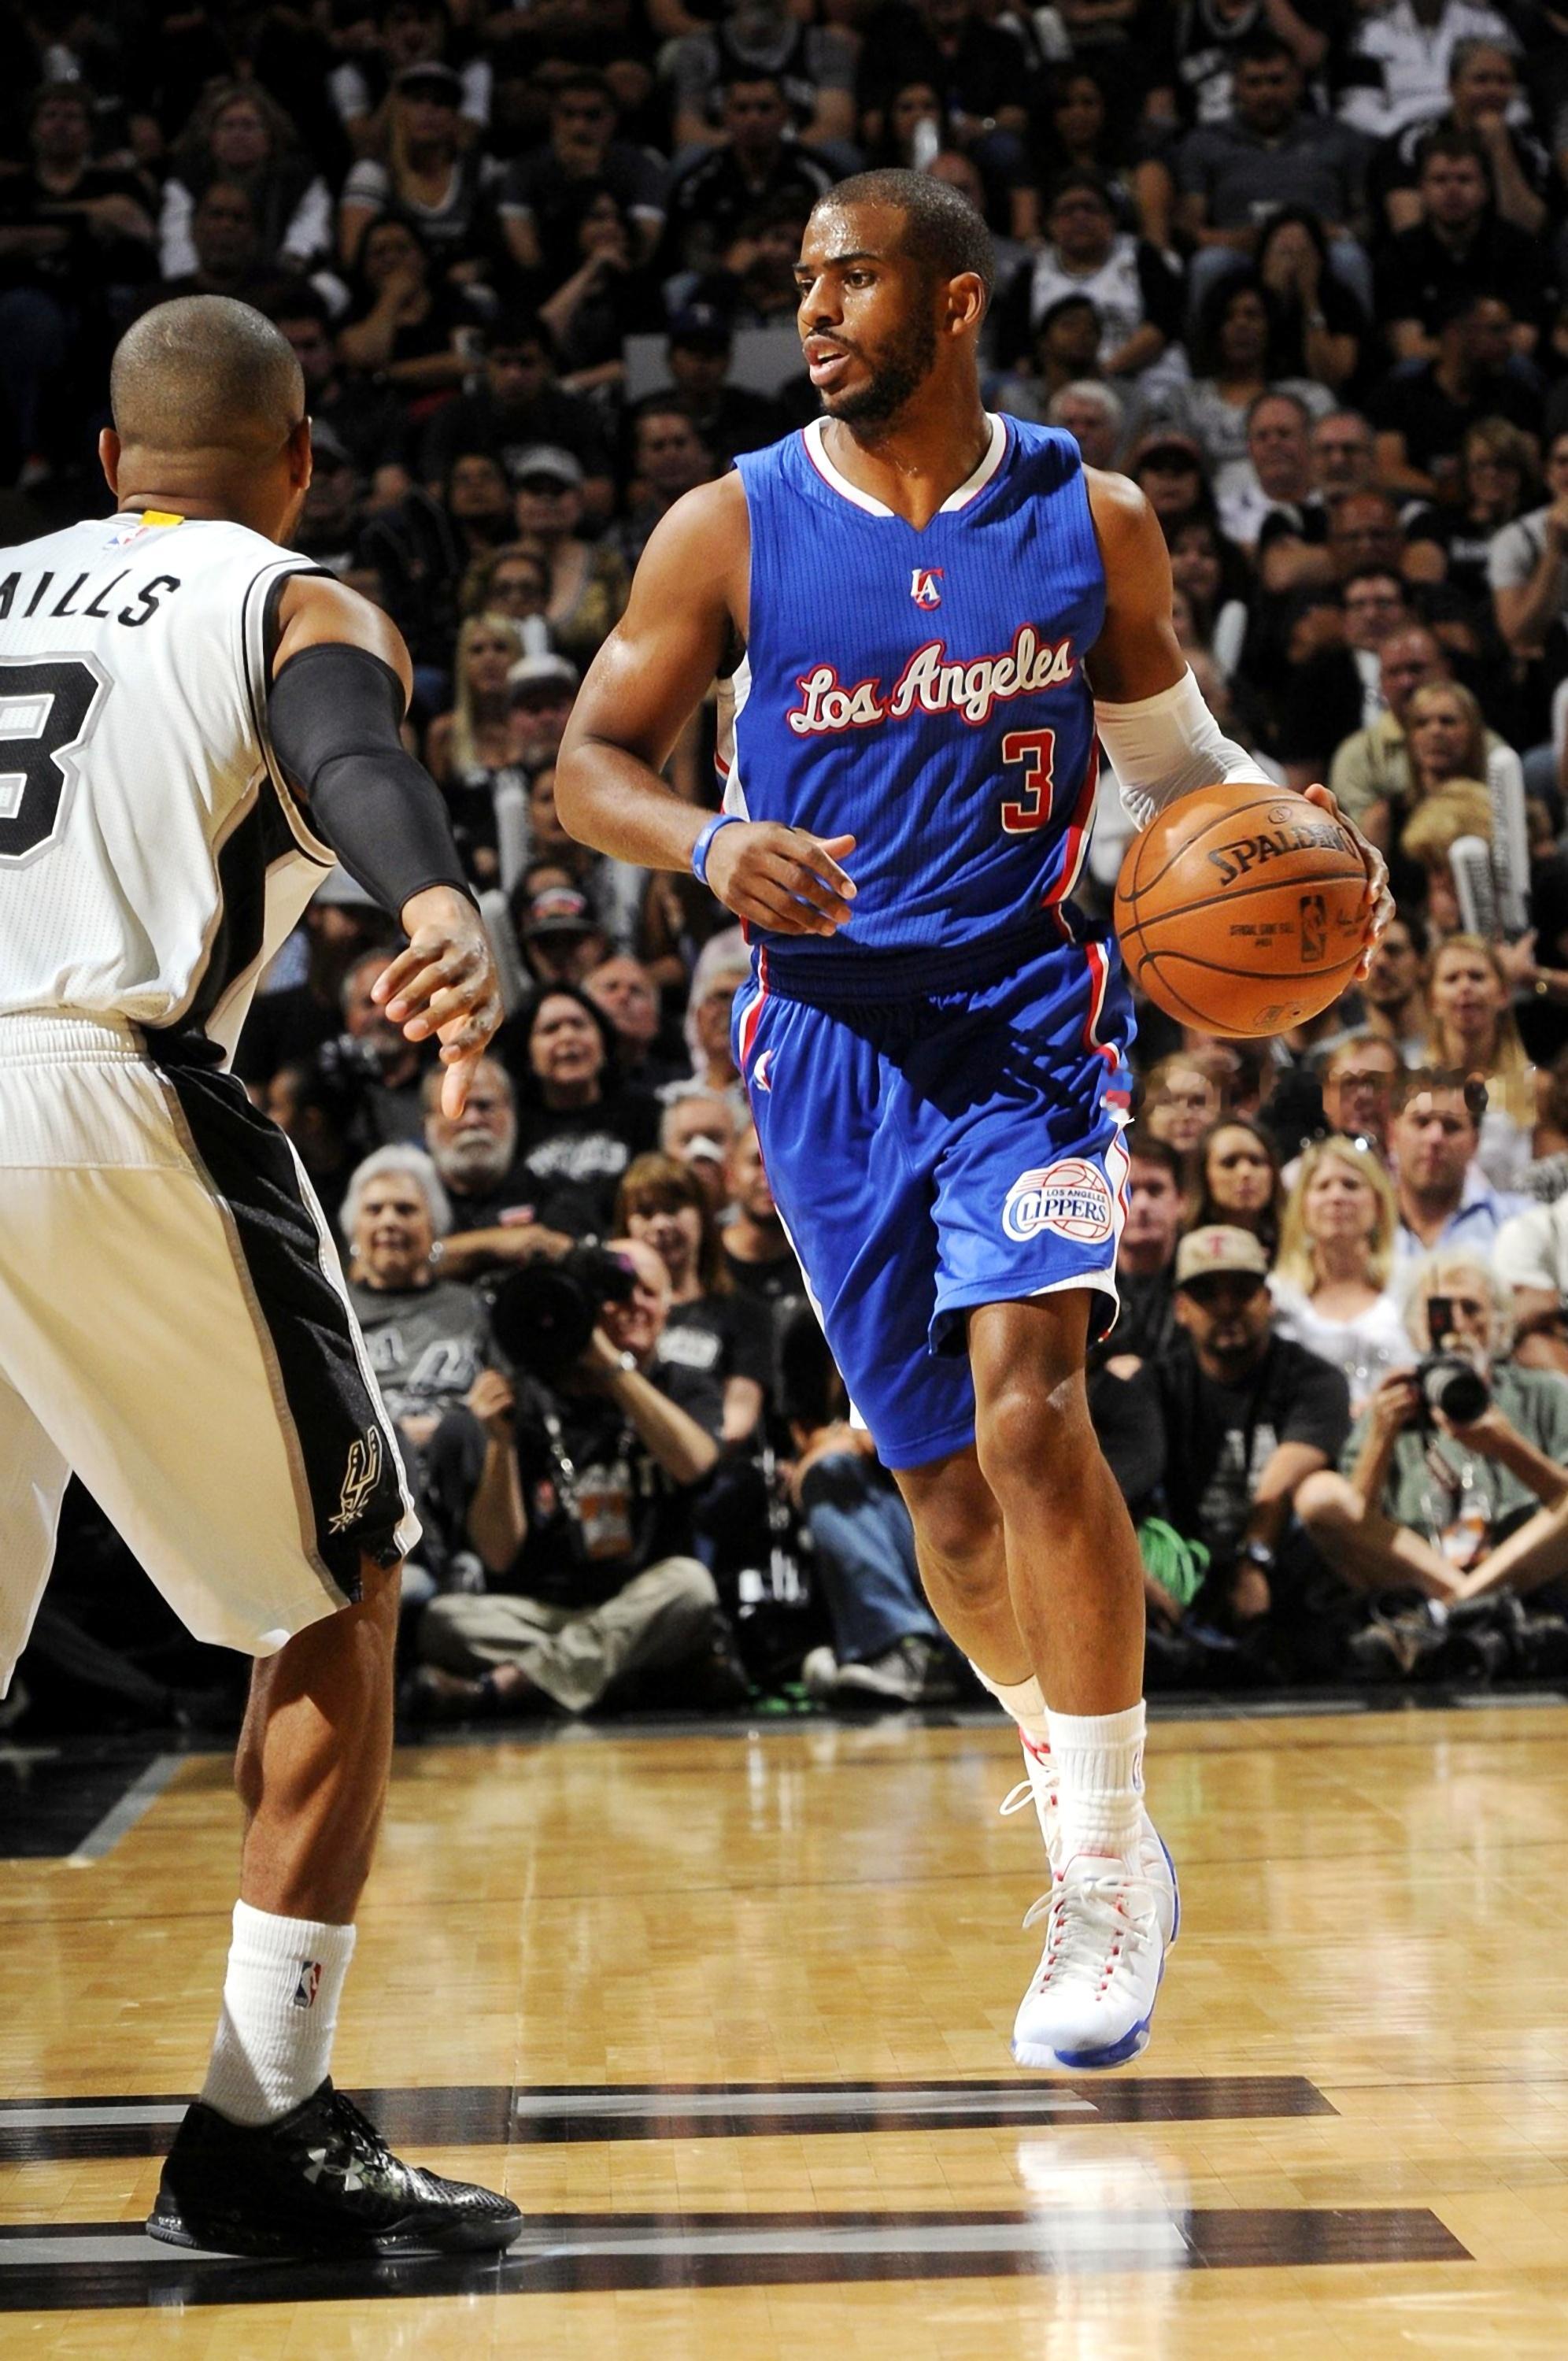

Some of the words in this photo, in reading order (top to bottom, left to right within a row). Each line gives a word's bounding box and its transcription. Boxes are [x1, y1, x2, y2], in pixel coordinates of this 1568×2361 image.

[787, 664, 885, 738] Los
[889, 623, 1077, 727] Angeles
[1001, 728, 1056, 834] 3
[1008, 1190, 1106, 1234] CLIPPERS
[1067, 1189, 1105, 1204] ANGELES
